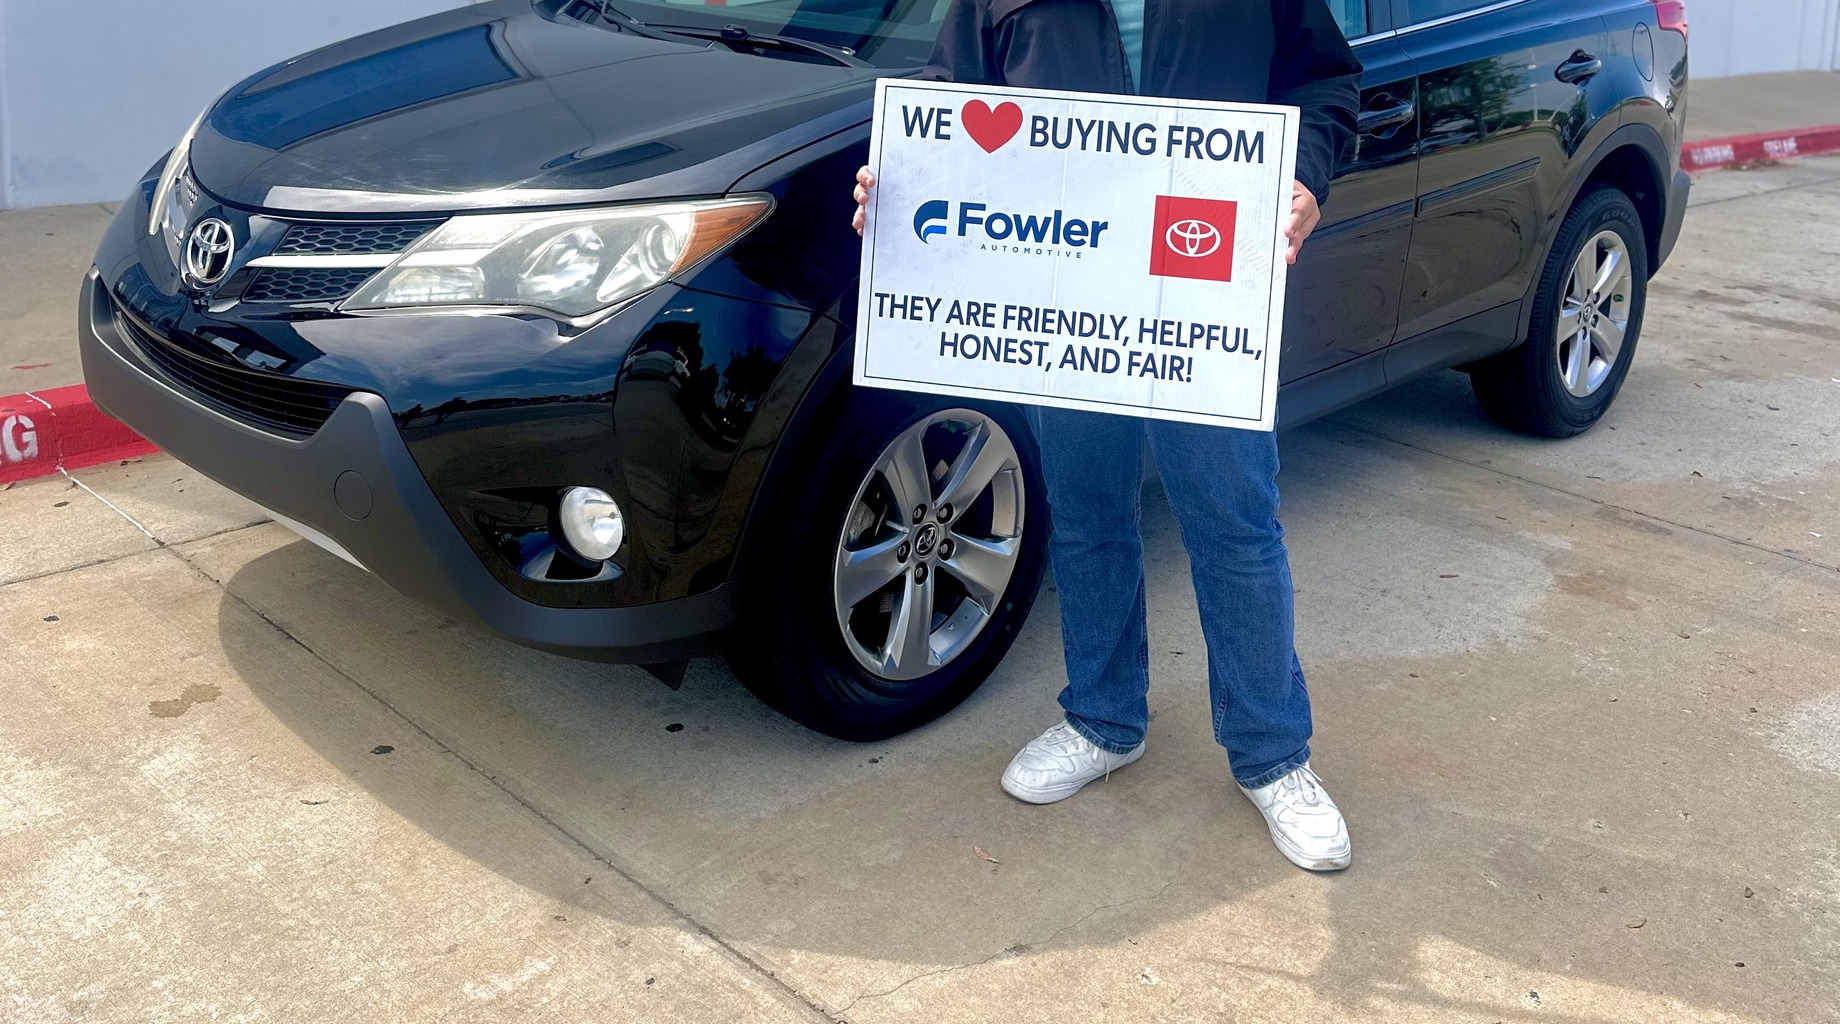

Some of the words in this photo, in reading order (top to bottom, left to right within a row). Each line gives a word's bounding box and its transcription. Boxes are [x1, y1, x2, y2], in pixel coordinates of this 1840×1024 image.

[902, 106, 952, 139] WE
[1030, 117, 1156, 155] BUYING
[1166, 125, 1265, 163] FROM
[958, 202, 1108, 248] Fowler
[980, 244, 1082, 259] AUTOMOTIVE
[875, 292, 942, 323] THEY
[946, 300, 996, 329] ARE
[1002, 305, 1130, 346] FRIENDLY,
[1138, 318, 1263, 360] HELPFUL,
[939, 332, 1052, 372] HONEST,
[1059, 346, 1121, 374] AND
[1127, 353, 1194, 383] FAIR!
